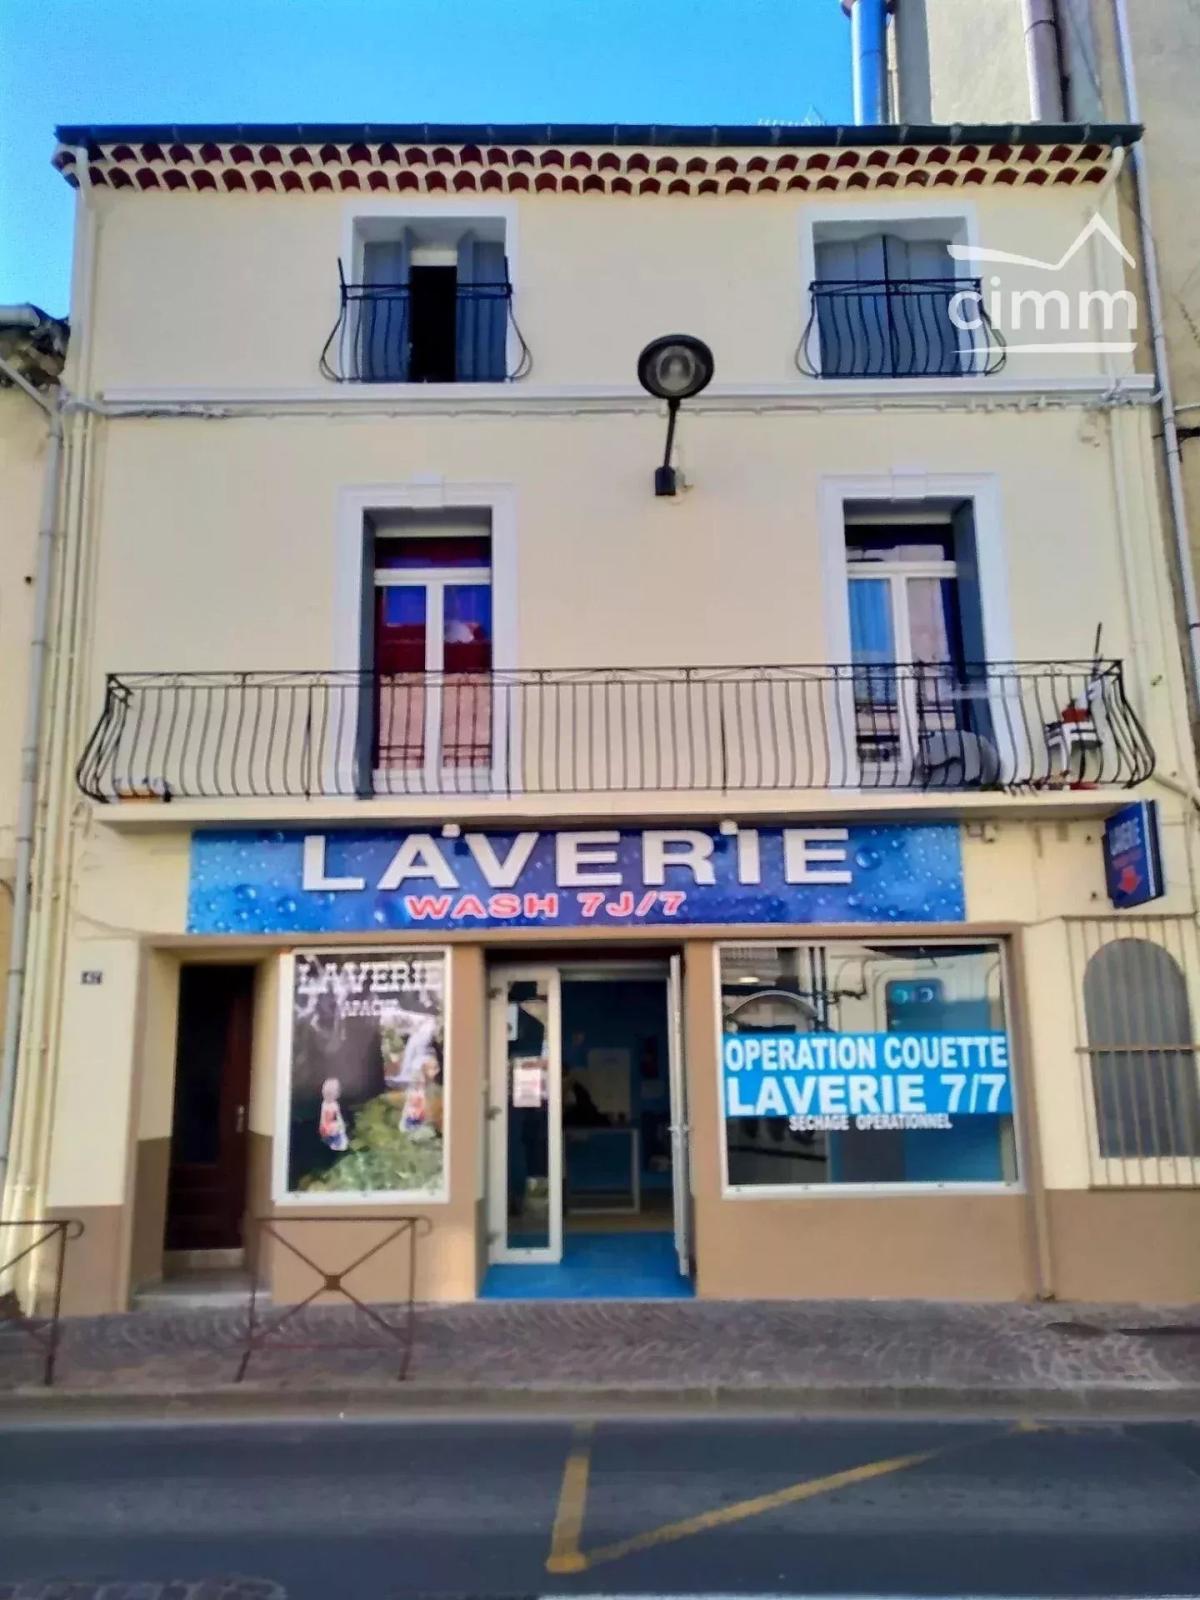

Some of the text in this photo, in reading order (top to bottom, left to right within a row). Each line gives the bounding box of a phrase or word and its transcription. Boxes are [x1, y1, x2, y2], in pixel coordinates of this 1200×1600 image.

[303, 827, 852, 891] LAVERIE
[405, 890, 687, 920] WASH 7J/7
[725, 1036, 1008, 1071] OPERATION COUETTE
[727, 1074, 1007, 1116] LAVERIE 7/7
[789, 1112, 953, 1131] SECHAGE OPERATIONNEL
